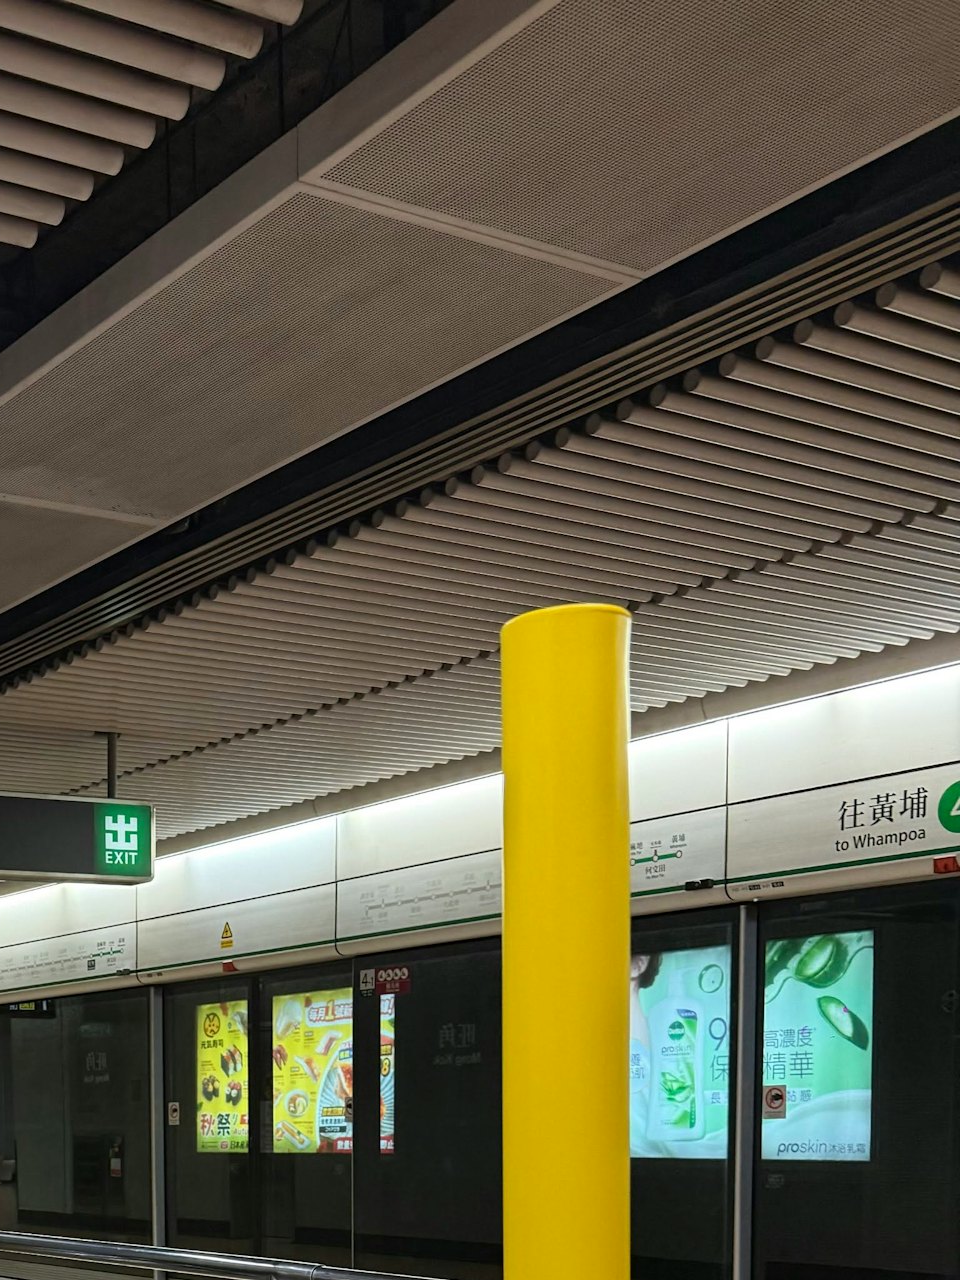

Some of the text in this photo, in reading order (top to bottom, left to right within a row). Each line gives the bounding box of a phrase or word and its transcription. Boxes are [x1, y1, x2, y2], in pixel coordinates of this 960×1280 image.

[838, 787, 929, 831] 往黃埔
[835, 828, 926, 852] to Whampoa
[105, 850, 138, 865] EXIT
[764, 1025, 813, 1049] 高濃度
[763, 1050, 814, 1080] 精華
[776, 1139, 828, 1157] proskin
